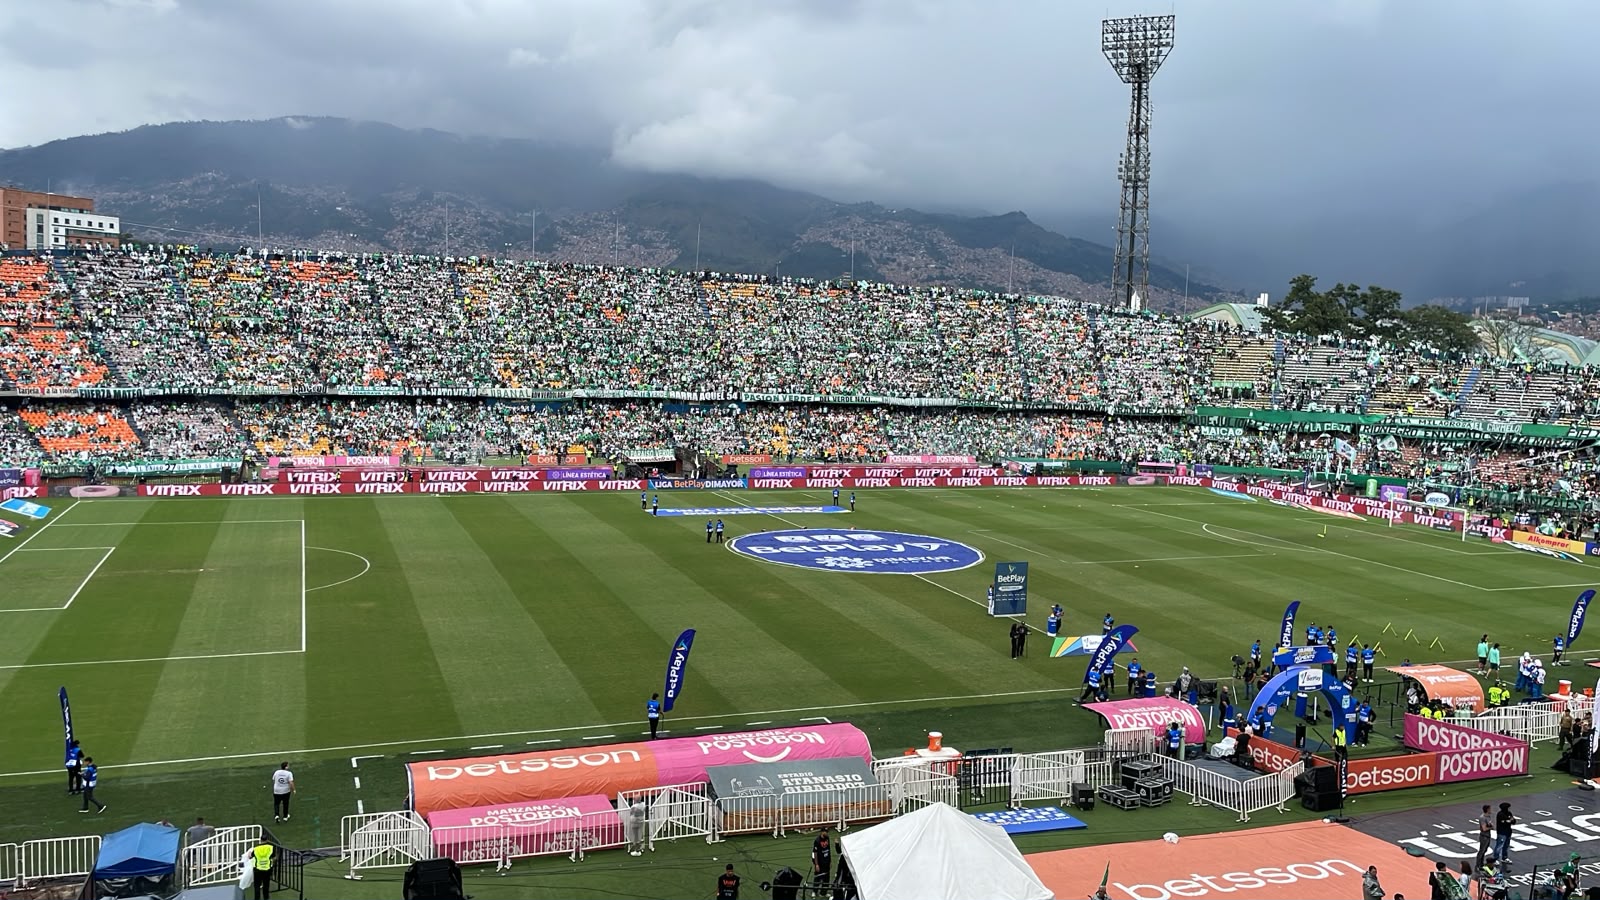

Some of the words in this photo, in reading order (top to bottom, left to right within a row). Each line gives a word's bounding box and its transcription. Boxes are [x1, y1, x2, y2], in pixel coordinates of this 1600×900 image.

[700, 391, 724, 400] AQUEL
[744, 393, 779, 402] PASION
[782, 394, 813, 402] VERDE
[537, 454, 577, 463] betson
[730, 454, 765, 463] betsson
[287, 472, 342, 482] VITRIX
[427, 471, 478, 480] VITRIX
[491, 470, 540, 480] VITRIX
[562, 470, 579, 479] LÍNEA
[580, 470, 607, 479] ESTÉTICA
[865, 469, 903, 477] VITRIX
[543, 480, 588, 490] VITRIX
[598, 480, 642, 490] VITRIX
[655, 480, 672, 488] LIGA
[754, 479, 793, 489] VITRIX
[806, 478, 844, 488] VITRIX
[854, 478, 891, 487] VITRIX
[901, 477, 936, 487] VITRIX
[947, 477, 981, 487] VITRIX
[993, 476, 1027, 486] VITRIX
[1037, 476, 1071, 486] VITRIX
[1079, 476, 1111, 485] VITRIX
[1169, 476, 1202, 487] VITRIX
[146, 485, 201, 496] VITRIX
[220, 483, 275, 496] VITRIX
[290, 483, 341, 494] VITRIX
[355, 483, 404, 494] VITRIX
[420, 481, 467, 492] VITRIX
[484, 481, 530, 492] VITRIX
[1211, 480, 1239, 492] VITRIX
[1246, 485, 1274, 498] VITRIX
[1282, 492, 1312, 505] VITRIX
[1322, 499, 1355, 512] VITRIX
[1527, 535, 1570, 549] Alkomprar
[747, 541, 907, 555] BetPlay
[997, 574, 1026, 584] BetPlay
[1282, 621, 1293, 647] tPlay
[667, 651, 685, 698] BetPlay
[426, 749, 641, 781] betsson
[1440, 747, 1525, 780] POSTOBON
[777, 771, 813, 779] ESTADIO
[781, 774, 863, 787] ATANASIO
[487, 804, 549, 816] MANZANA
[1111, 858, 1366, 900] betsson
